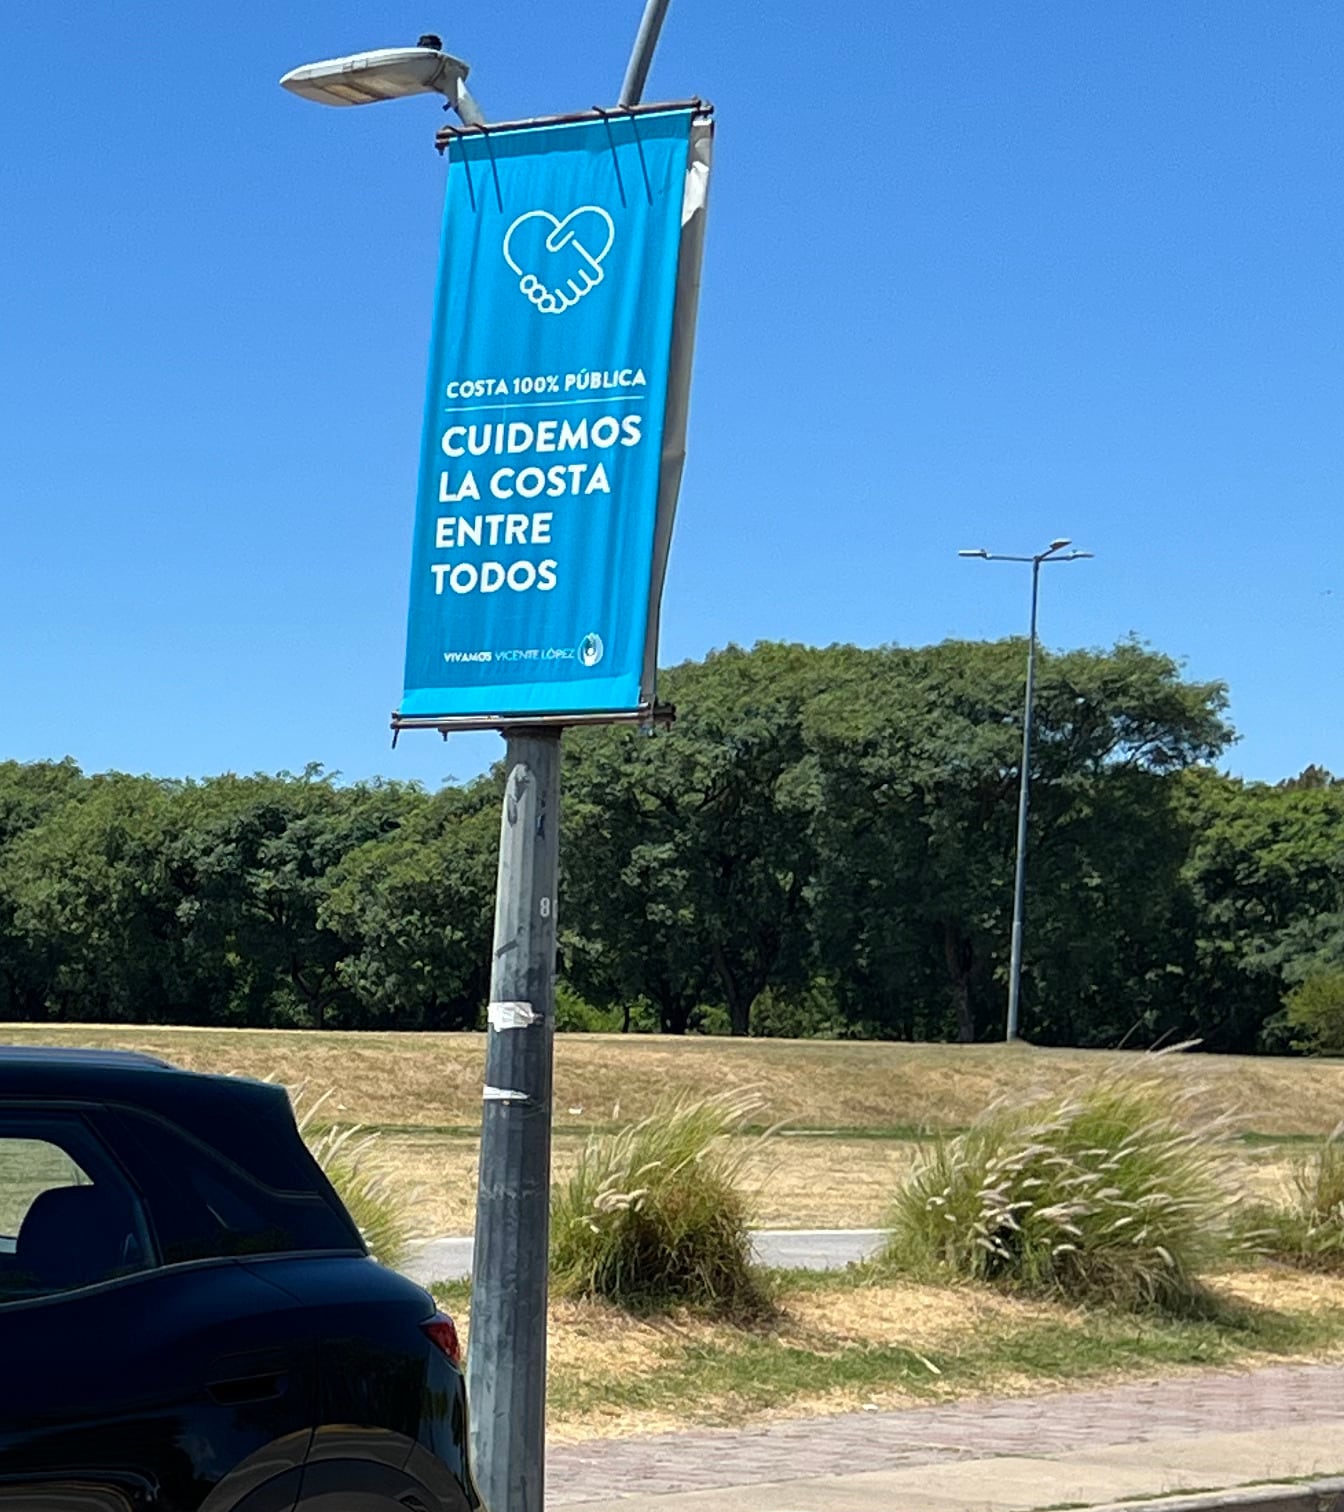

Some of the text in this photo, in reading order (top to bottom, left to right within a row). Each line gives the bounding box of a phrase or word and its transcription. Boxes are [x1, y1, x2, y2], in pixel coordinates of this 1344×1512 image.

[446, 367, 646, 399] COSTA 100% PÚBLICA
[441, 415, 642, 457] CUIDEMOS
[439, 462, 611, 503] LA COSTA
[436, 512, 553, 549] ENTRE
[431, 559, 558, 595] TODOS
[443, 651, 492, 663] VIVAMOS
[495, 649, 539, 662] VICENTE
